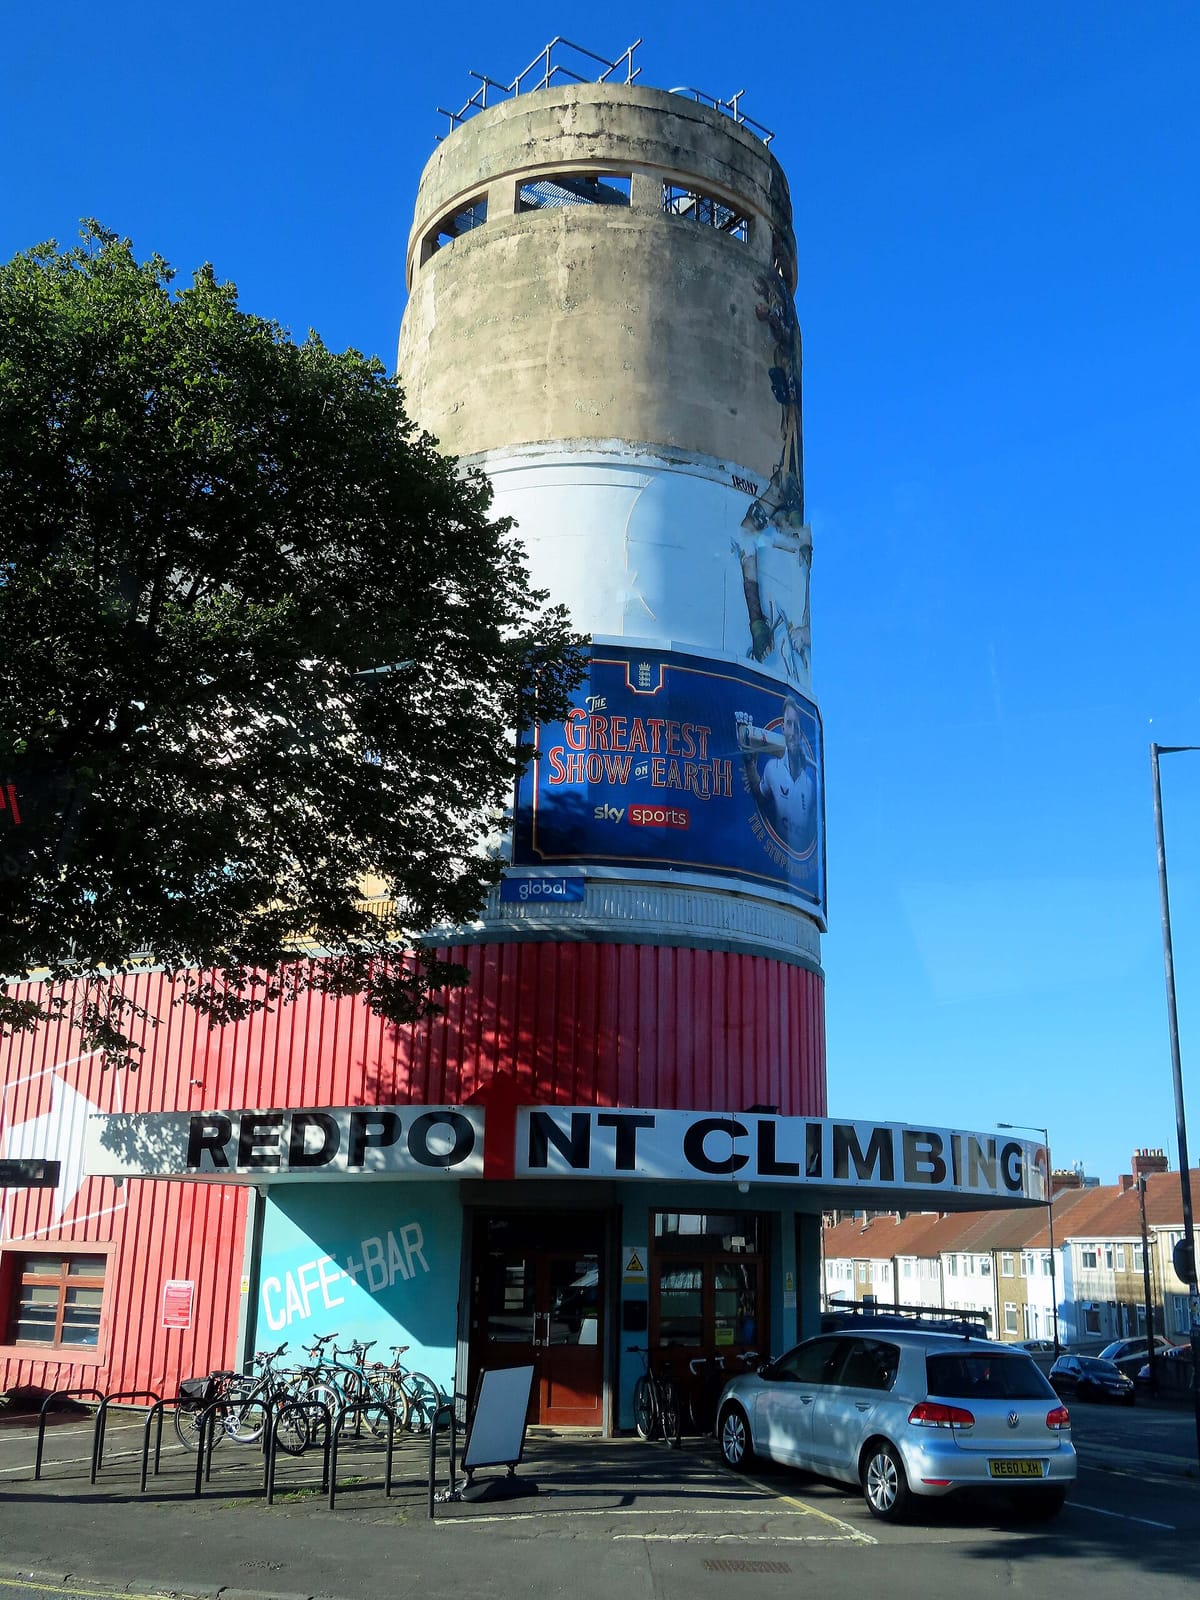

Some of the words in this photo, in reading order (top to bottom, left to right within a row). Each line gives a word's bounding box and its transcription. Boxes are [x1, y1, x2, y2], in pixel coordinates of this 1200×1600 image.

[585, 695, 607, 713] THE
[564, 708, 711, 760] GREATEST
[548, 746, 632, 785] SHOW
[634, 764, 648, 777] ON
[651, 757, 733, 800] EARTH
[594, 803, 624, 823] sky
[632, 808, 687, 825] sports
[519, 880, 566, 899] global
[683, 1117, 1025, 1192] CLIMBING
[994, 1462, 1019, 1474] RE60
